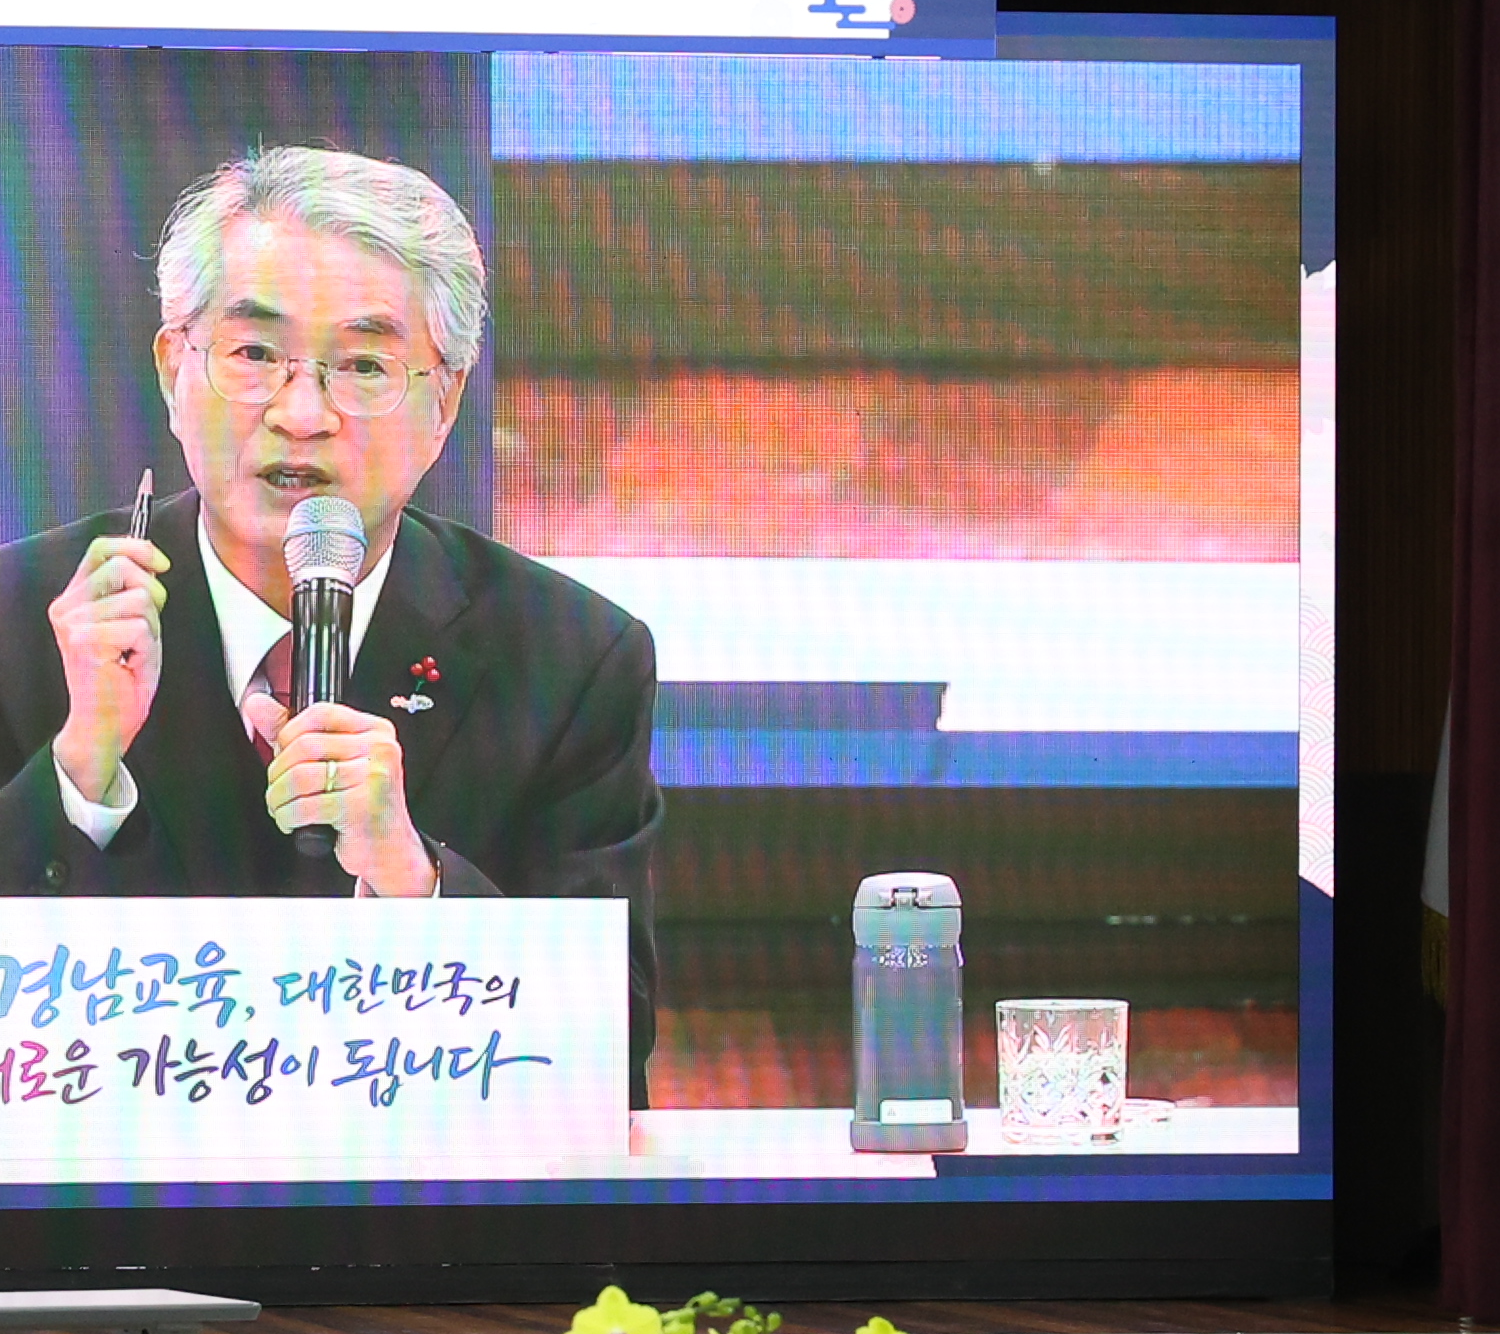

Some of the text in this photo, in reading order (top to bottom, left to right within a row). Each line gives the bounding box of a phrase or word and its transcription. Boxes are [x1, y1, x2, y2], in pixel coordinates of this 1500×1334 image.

[273, 958, 520, 1016] 대한민국의
[117, 1034, 319, 1105] 가능성이
[331, 1030, 553, 1107] 됩니다
